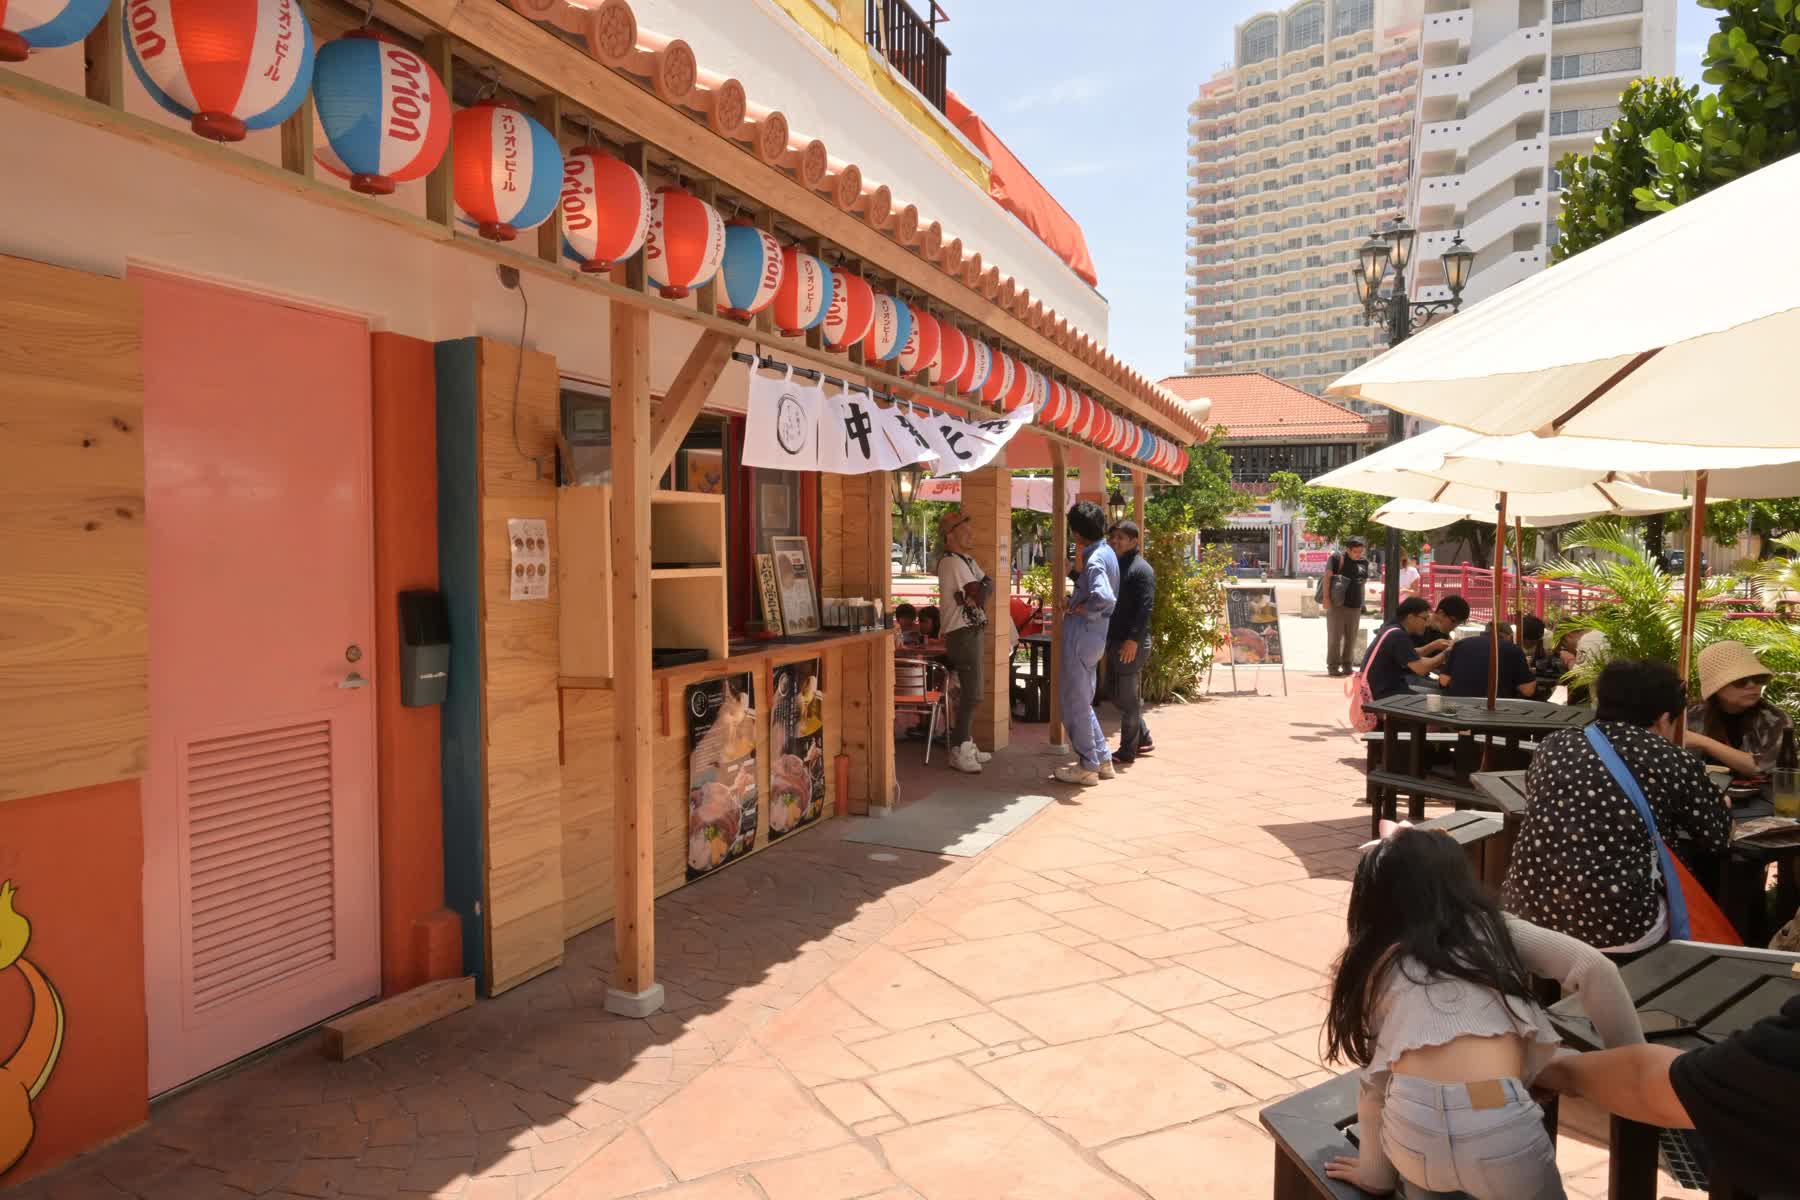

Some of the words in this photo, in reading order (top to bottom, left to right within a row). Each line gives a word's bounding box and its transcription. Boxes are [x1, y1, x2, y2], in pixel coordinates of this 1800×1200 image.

[387, 50, 430, 142] Orion
[502, 114, 516, 192] オリオンビール
[561, 160, 593, 231] Orion
[763, 233, 783, 289] Orion
[804, 260, 814, 314] オリオンビール
